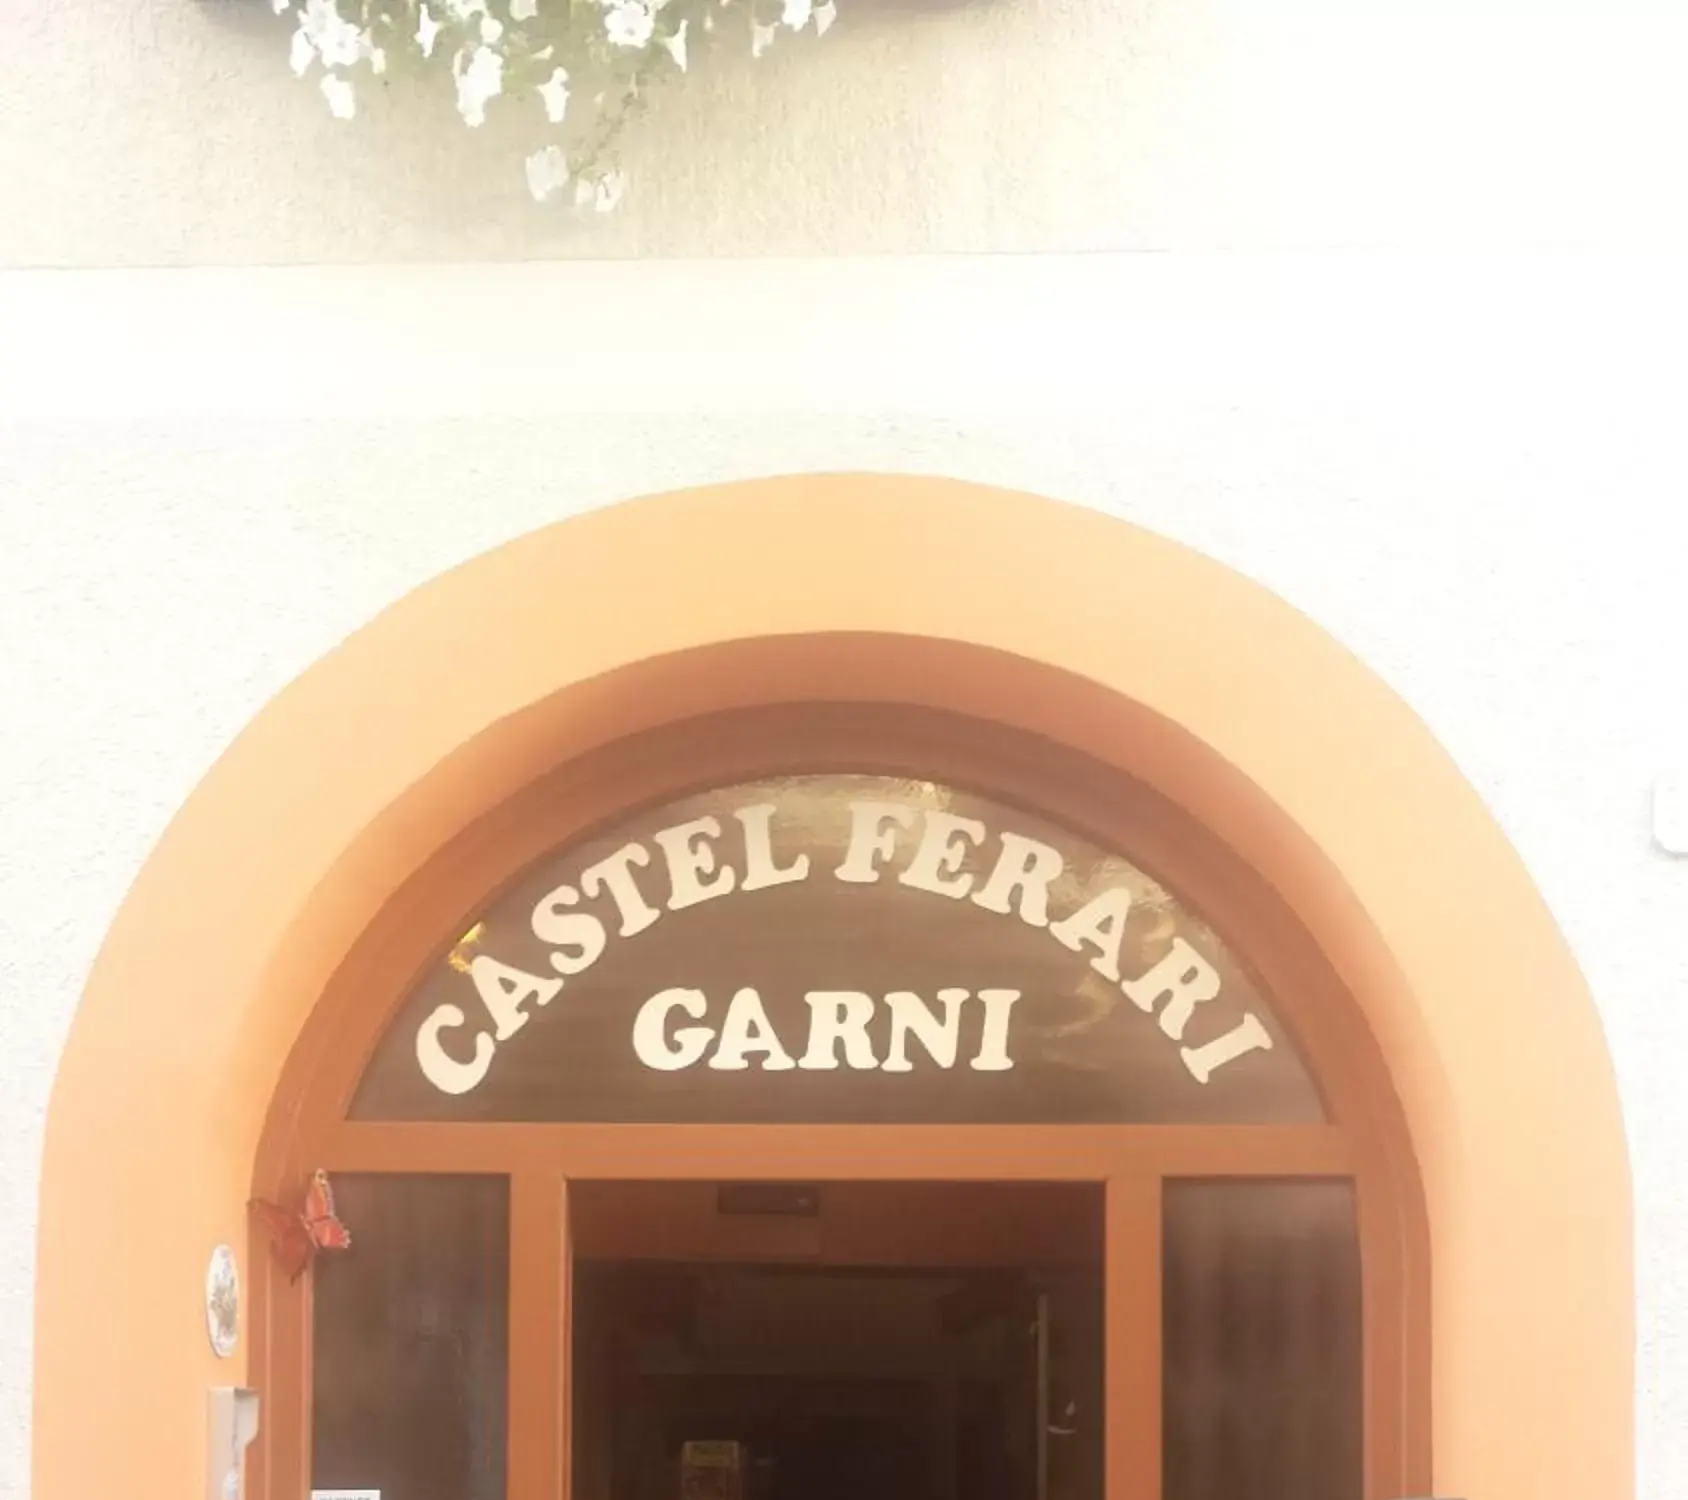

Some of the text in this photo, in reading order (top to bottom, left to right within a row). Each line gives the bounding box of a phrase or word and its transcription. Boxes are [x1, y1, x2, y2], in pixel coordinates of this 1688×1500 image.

[416, 801, 1273, 1095] CASTEL FERARI
[632, 986, 1022, 1072] GARNI
